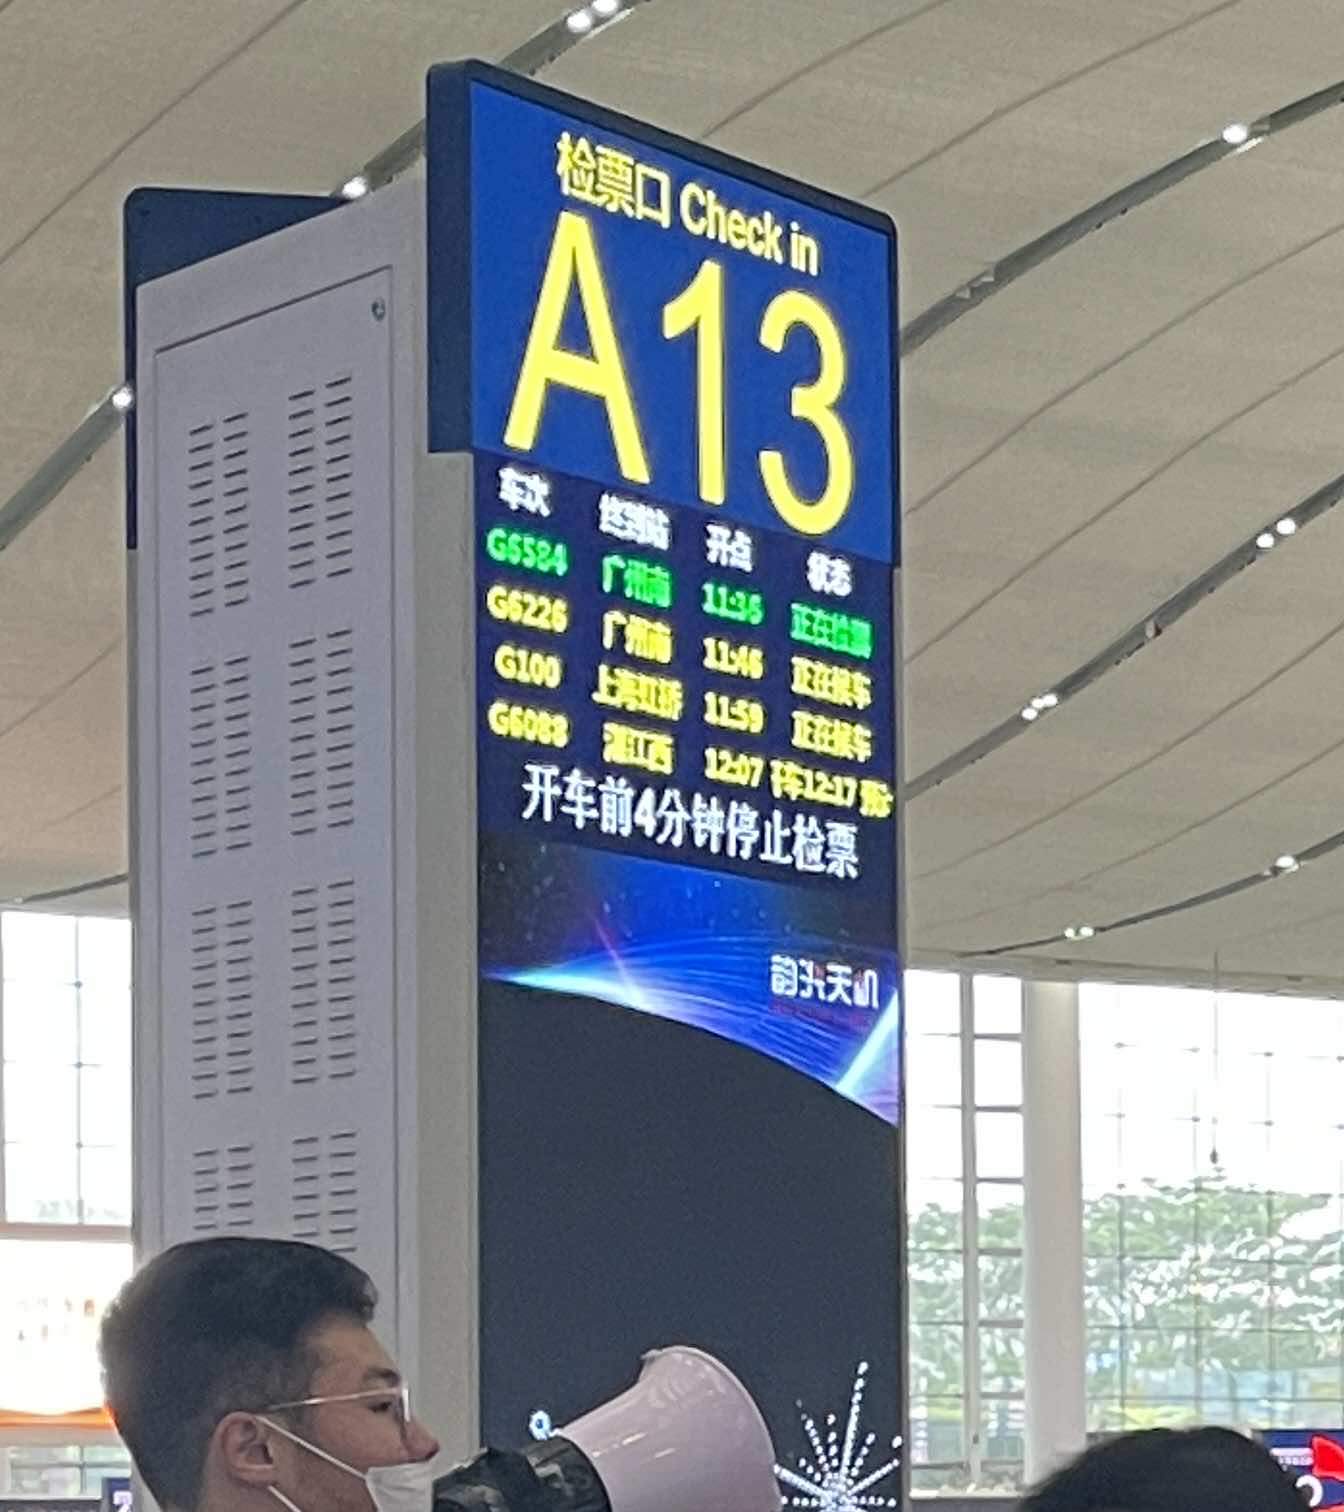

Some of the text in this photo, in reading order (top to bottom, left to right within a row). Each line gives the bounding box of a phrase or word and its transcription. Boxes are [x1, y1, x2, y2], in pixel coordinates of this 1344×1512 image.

[557, 132, 819, 276] 检票口 Check in
[504, 211, 853, 536] A13
[495, 645, 562, 688] G100
[521, 762, 860, 880] 开车前4分钟停止检票
